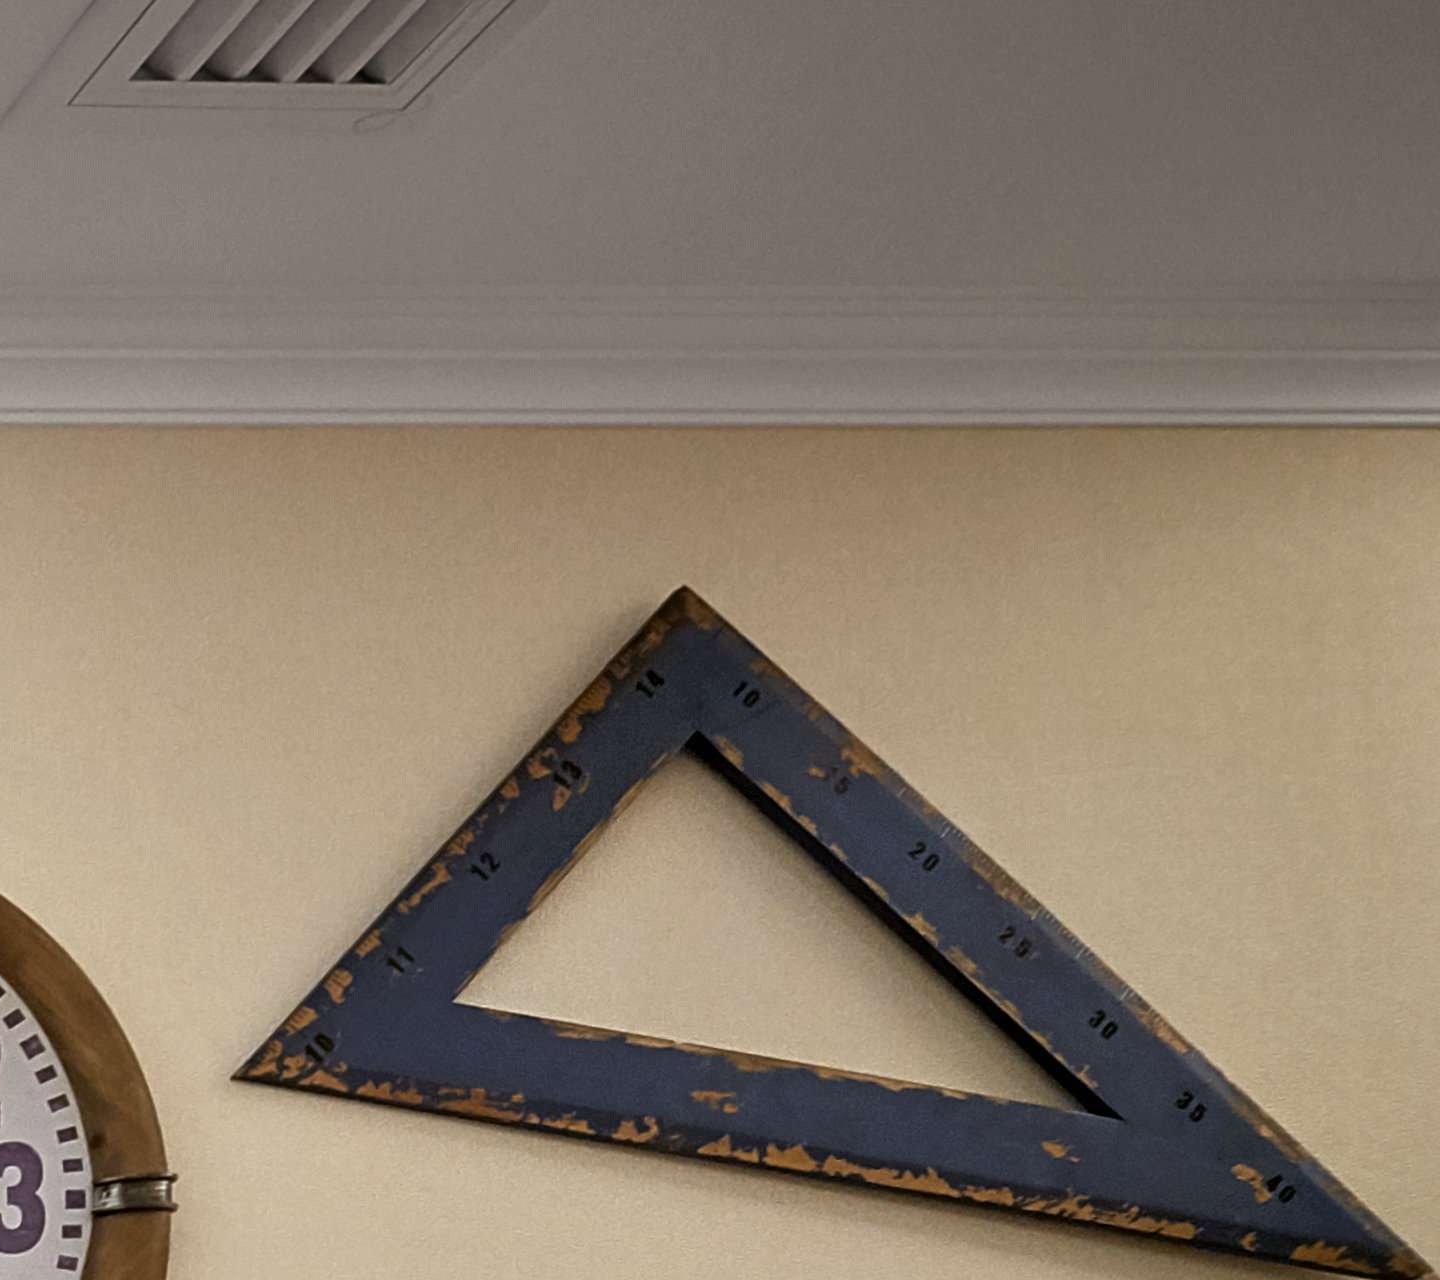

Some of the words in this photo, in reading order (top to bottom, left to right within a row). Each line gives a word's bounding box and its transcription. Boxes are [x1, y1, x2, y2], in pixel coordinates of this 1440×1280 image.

[636, 670, 664, 698] 14
[733, 681, 760, 707] 10
[553, 760, 582, 788] 13
[470, 852, 500, 880] 12
[908, 842, 939, 871] 20
[999, 926, 1032, 958] 25
[387, 946, 414, 973] 11
[1089, 1010, 1118, 1039] 30
[305, 1033, 334, 1064] 10
[1176, 1091, 1207, 1122] 35
[1266, 1175, 1296, 1203] 40
